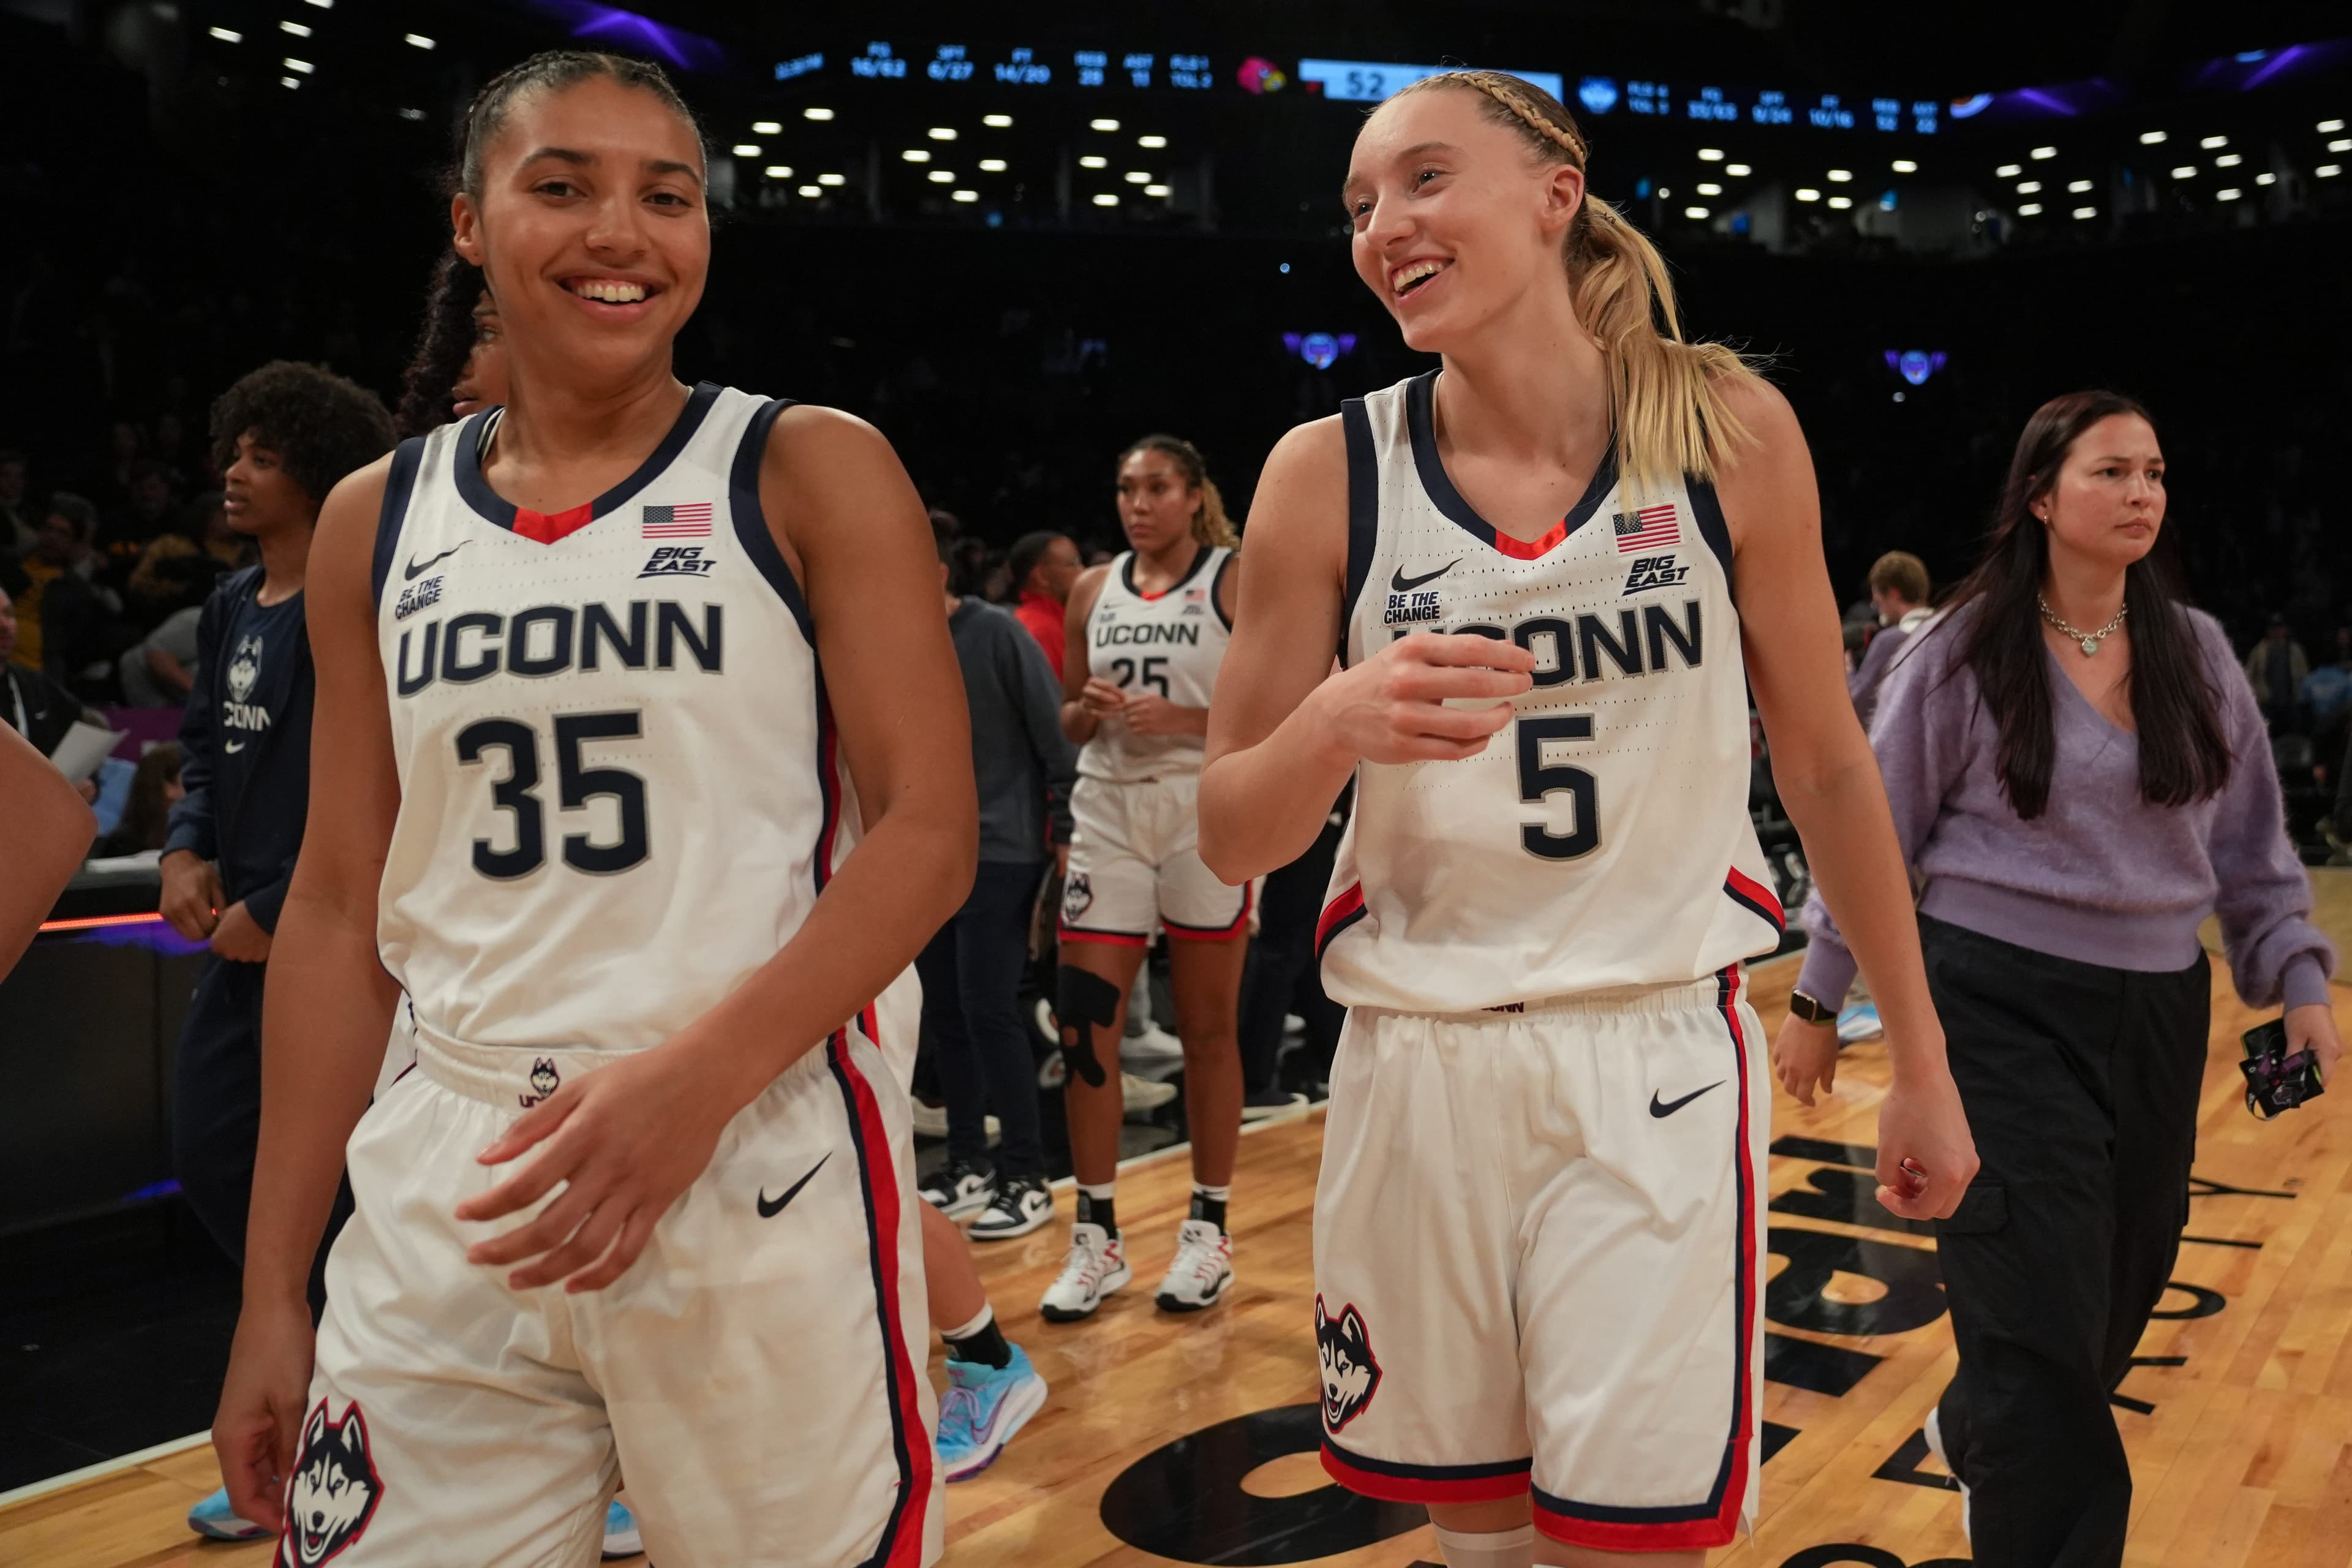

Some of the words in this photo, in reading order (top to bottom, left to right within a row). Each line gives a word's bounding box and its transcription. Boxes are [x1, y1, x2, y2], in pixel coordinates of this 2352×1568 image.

[1348, 70, 1384, 97] 52
[643, 560, 717, 572] EAST
[651, 547, 704, 559] BIG
[1631, 554, 1676, 573] BIG
[400, 586, 416, 602] BE
[418, 575, 444, 594] THE
[1626, 567, 1689, 588] EAST
[396, 588, 442, 619] CHANGE
[1388, 594, 1407, 609] BE
[1411, 592, 1439, 606] THE
[1384, 605, 1440, 624] CHANGE
[1096, 622, 1199, 647] UCONN
[1391, 598, 1703, 690] ONN
[396, 599, 725, 699] UCONN
[1111, 657, 1169, 698] 25
[455, 709, 652, 882] 35
[1515, 713, 1602, 862] 5
